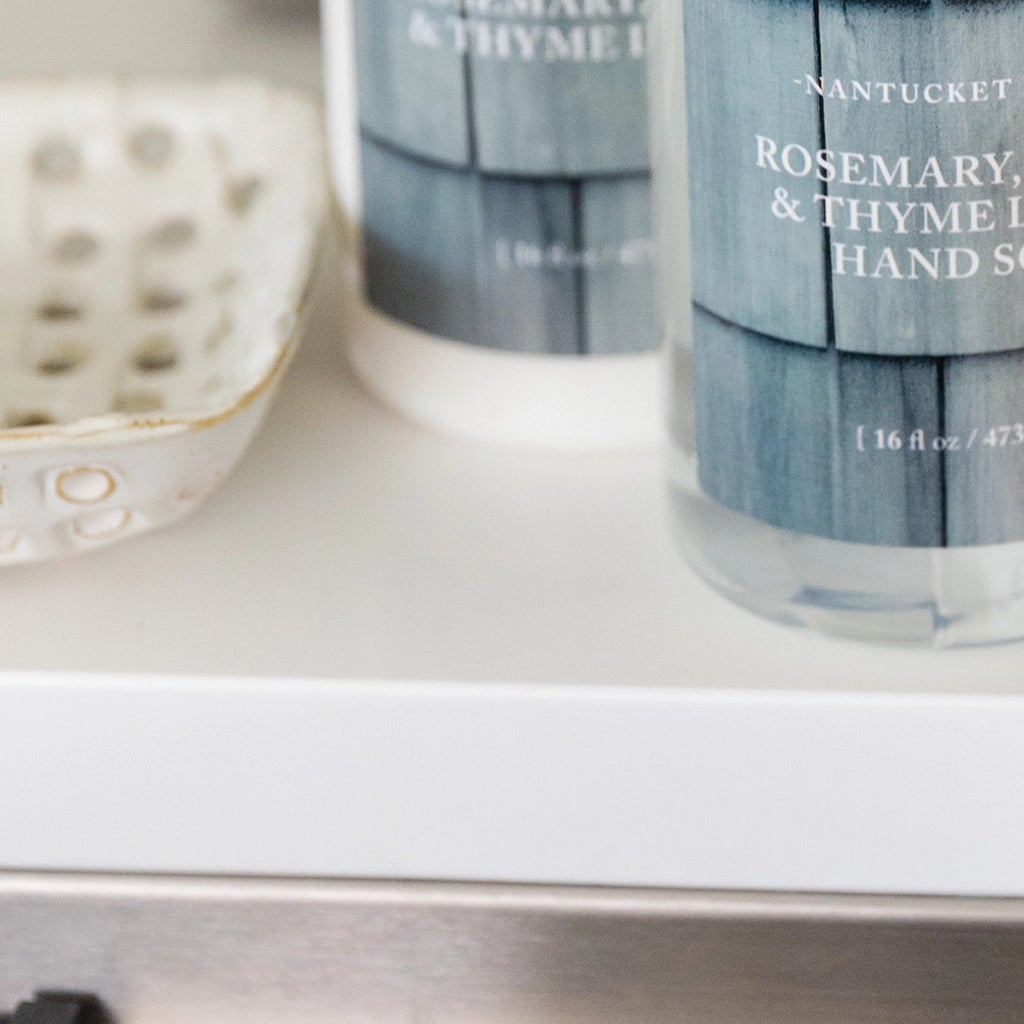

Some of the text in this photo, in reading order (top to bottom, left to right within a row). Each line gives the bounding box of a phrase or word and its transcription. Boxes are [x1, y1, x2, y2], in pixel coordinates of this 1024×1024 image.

[445, 14, 620, 65] THYME
[755, 134, 1021, 188] ROSEMARY,
[771, 187, 806, 223] &
[813, 193, 996, 235] THYME
[832, 242, 980, 280] HAND
[874, 428, 902, 451] 16
[909, 428, 926, 451] fl
[932, 436, 960, 451] oz
[983, 422, 1024, 447] 473
